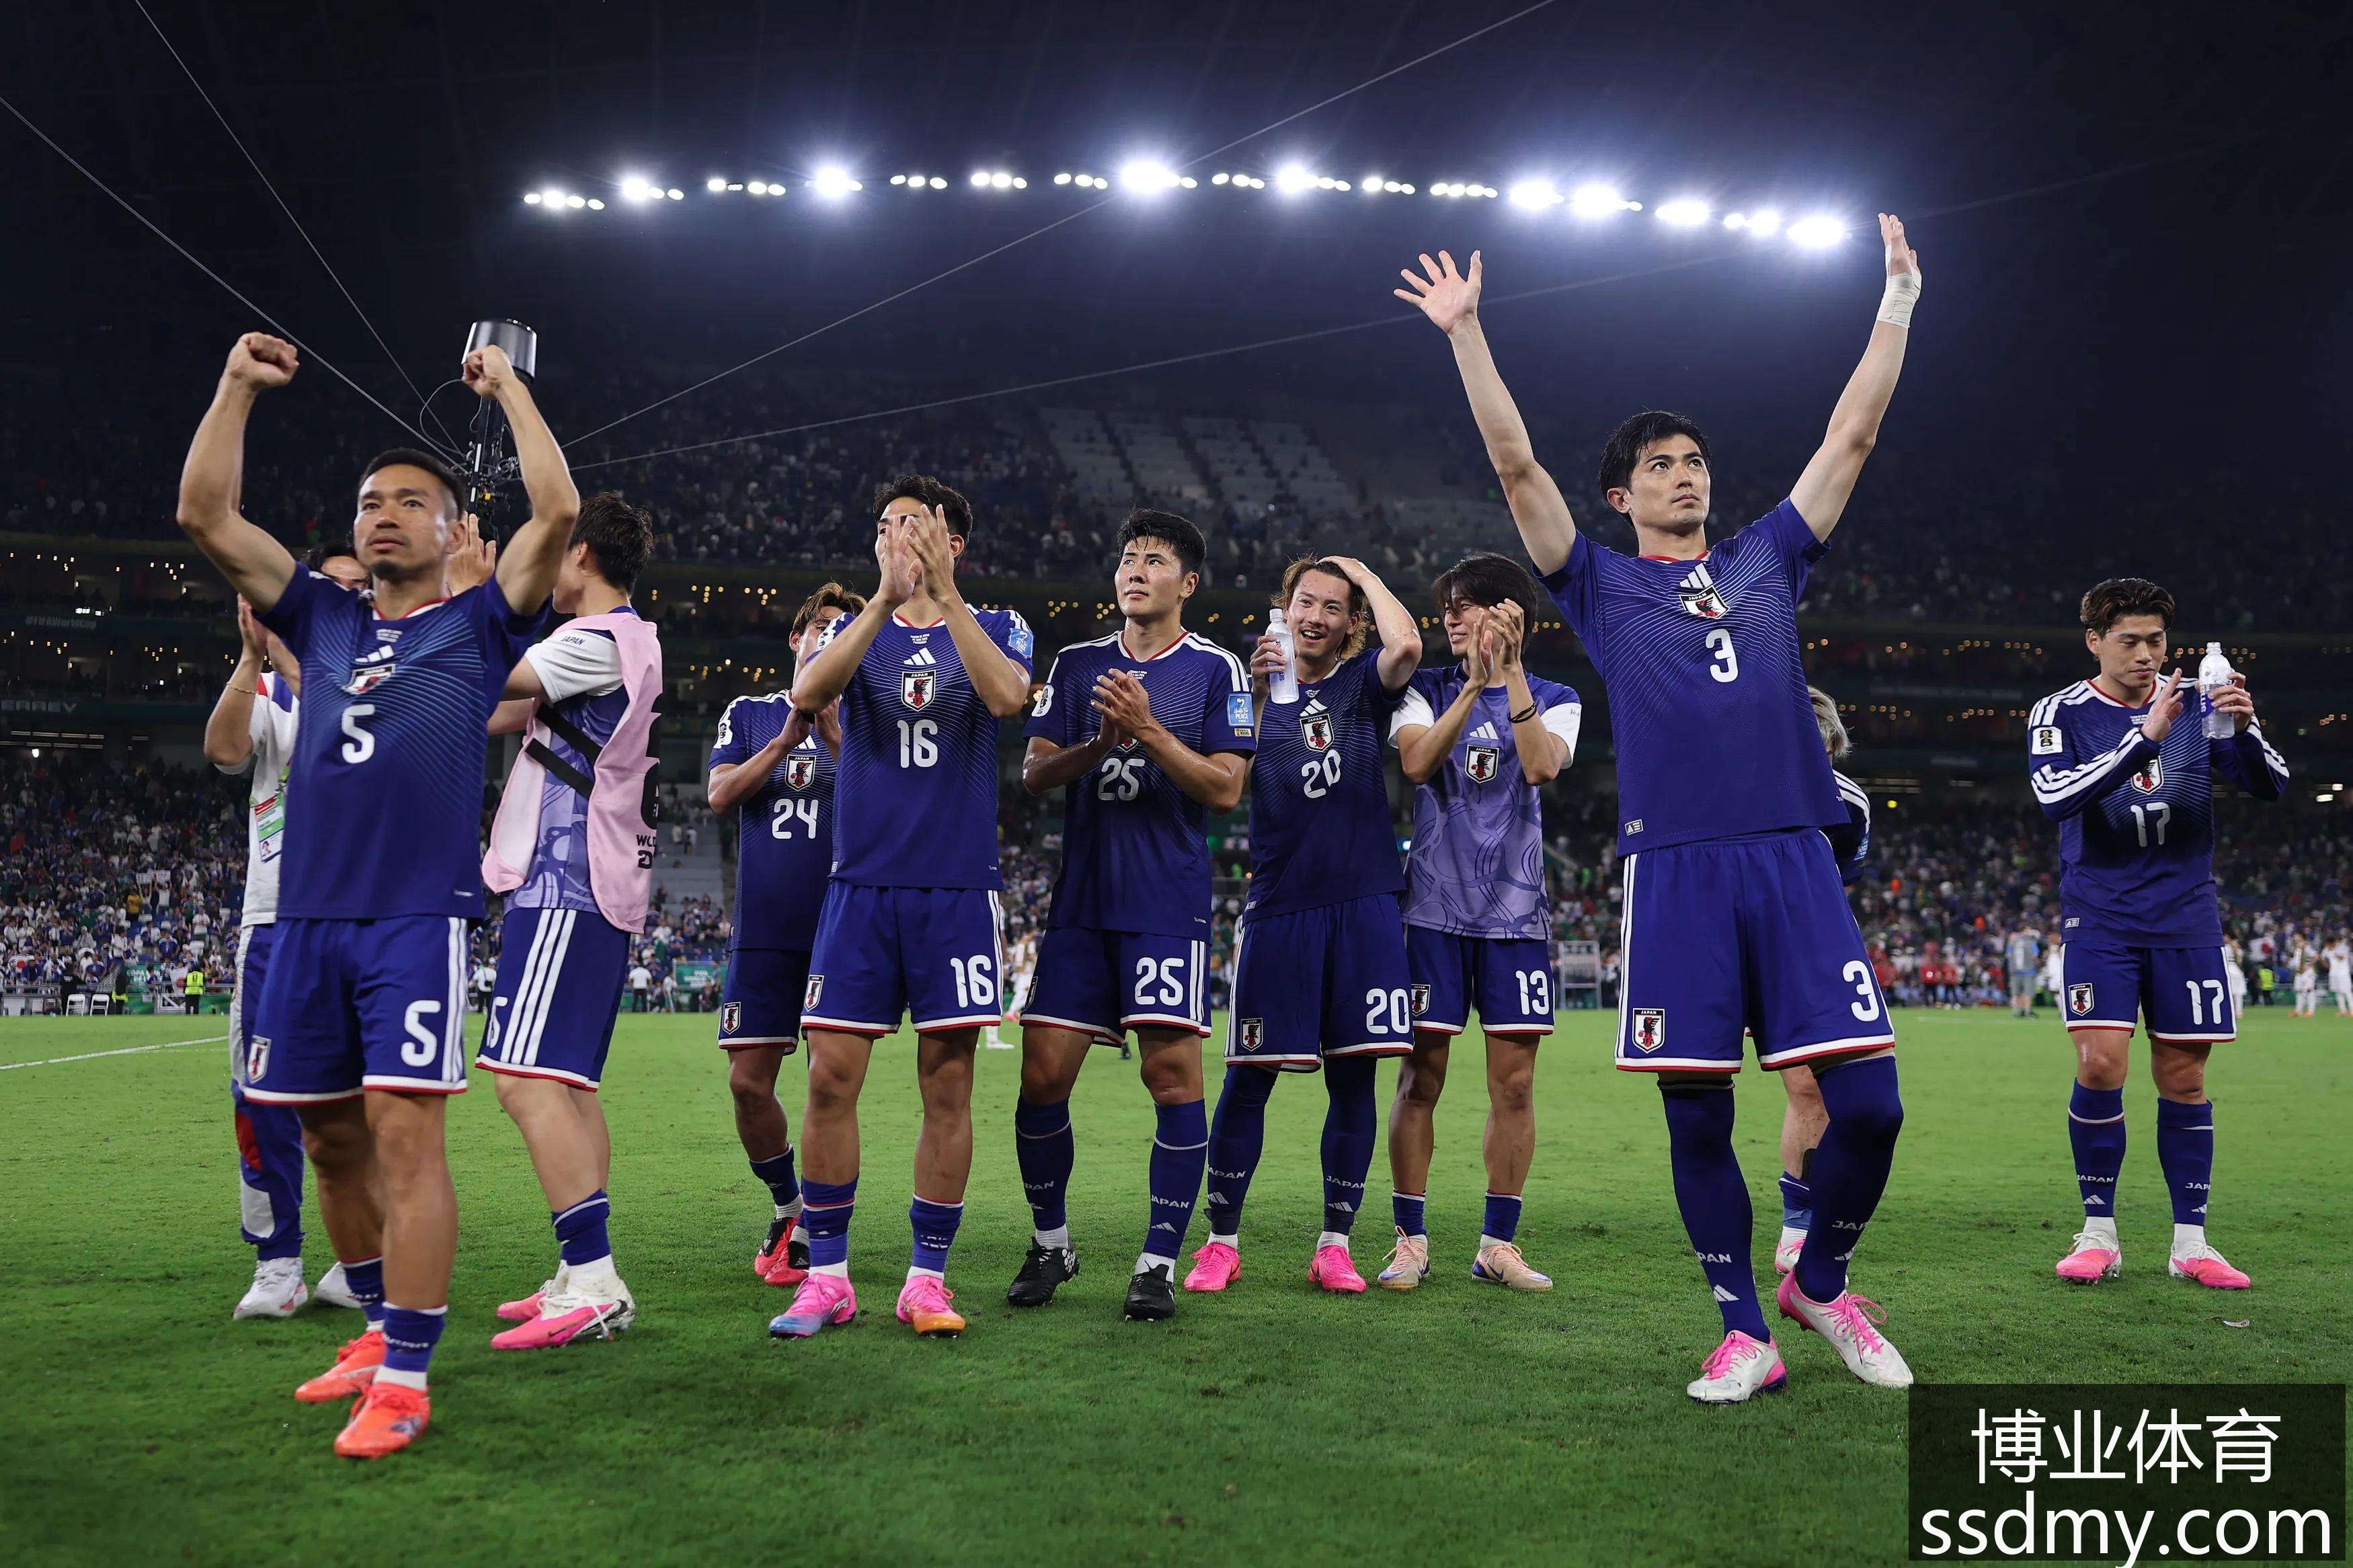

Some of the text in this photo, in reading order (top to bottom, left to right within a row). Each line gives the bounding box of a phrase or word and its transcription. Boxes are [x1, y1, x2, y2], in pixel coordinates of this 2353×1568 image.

[1688, 592, 1707, 600] JAPAN
[1705, 628, 1739, 683] 3
[342, 704, 374, 764] 5
[897, 719, 938, 768] 16
[1098, 757, 1146, 800] 25
[1301, 749, 1341, 798] 20
[772, 798, 819, 839] 24
[2130, 802, 2170, 848] 17
[950, 954, 994, 1008] 16
[1135, 957, 1185, 1006] 25
[1515, 970, 1549, 1016] 13
[1842, 960, 1880, 1022] 3
[2186, 979, 2224, 1025] 17
[401, 1000, 440, 1067] 5
[1366, 988, 1410, 1034] 20
[1207, 1164, 1246, 1179] APAN
